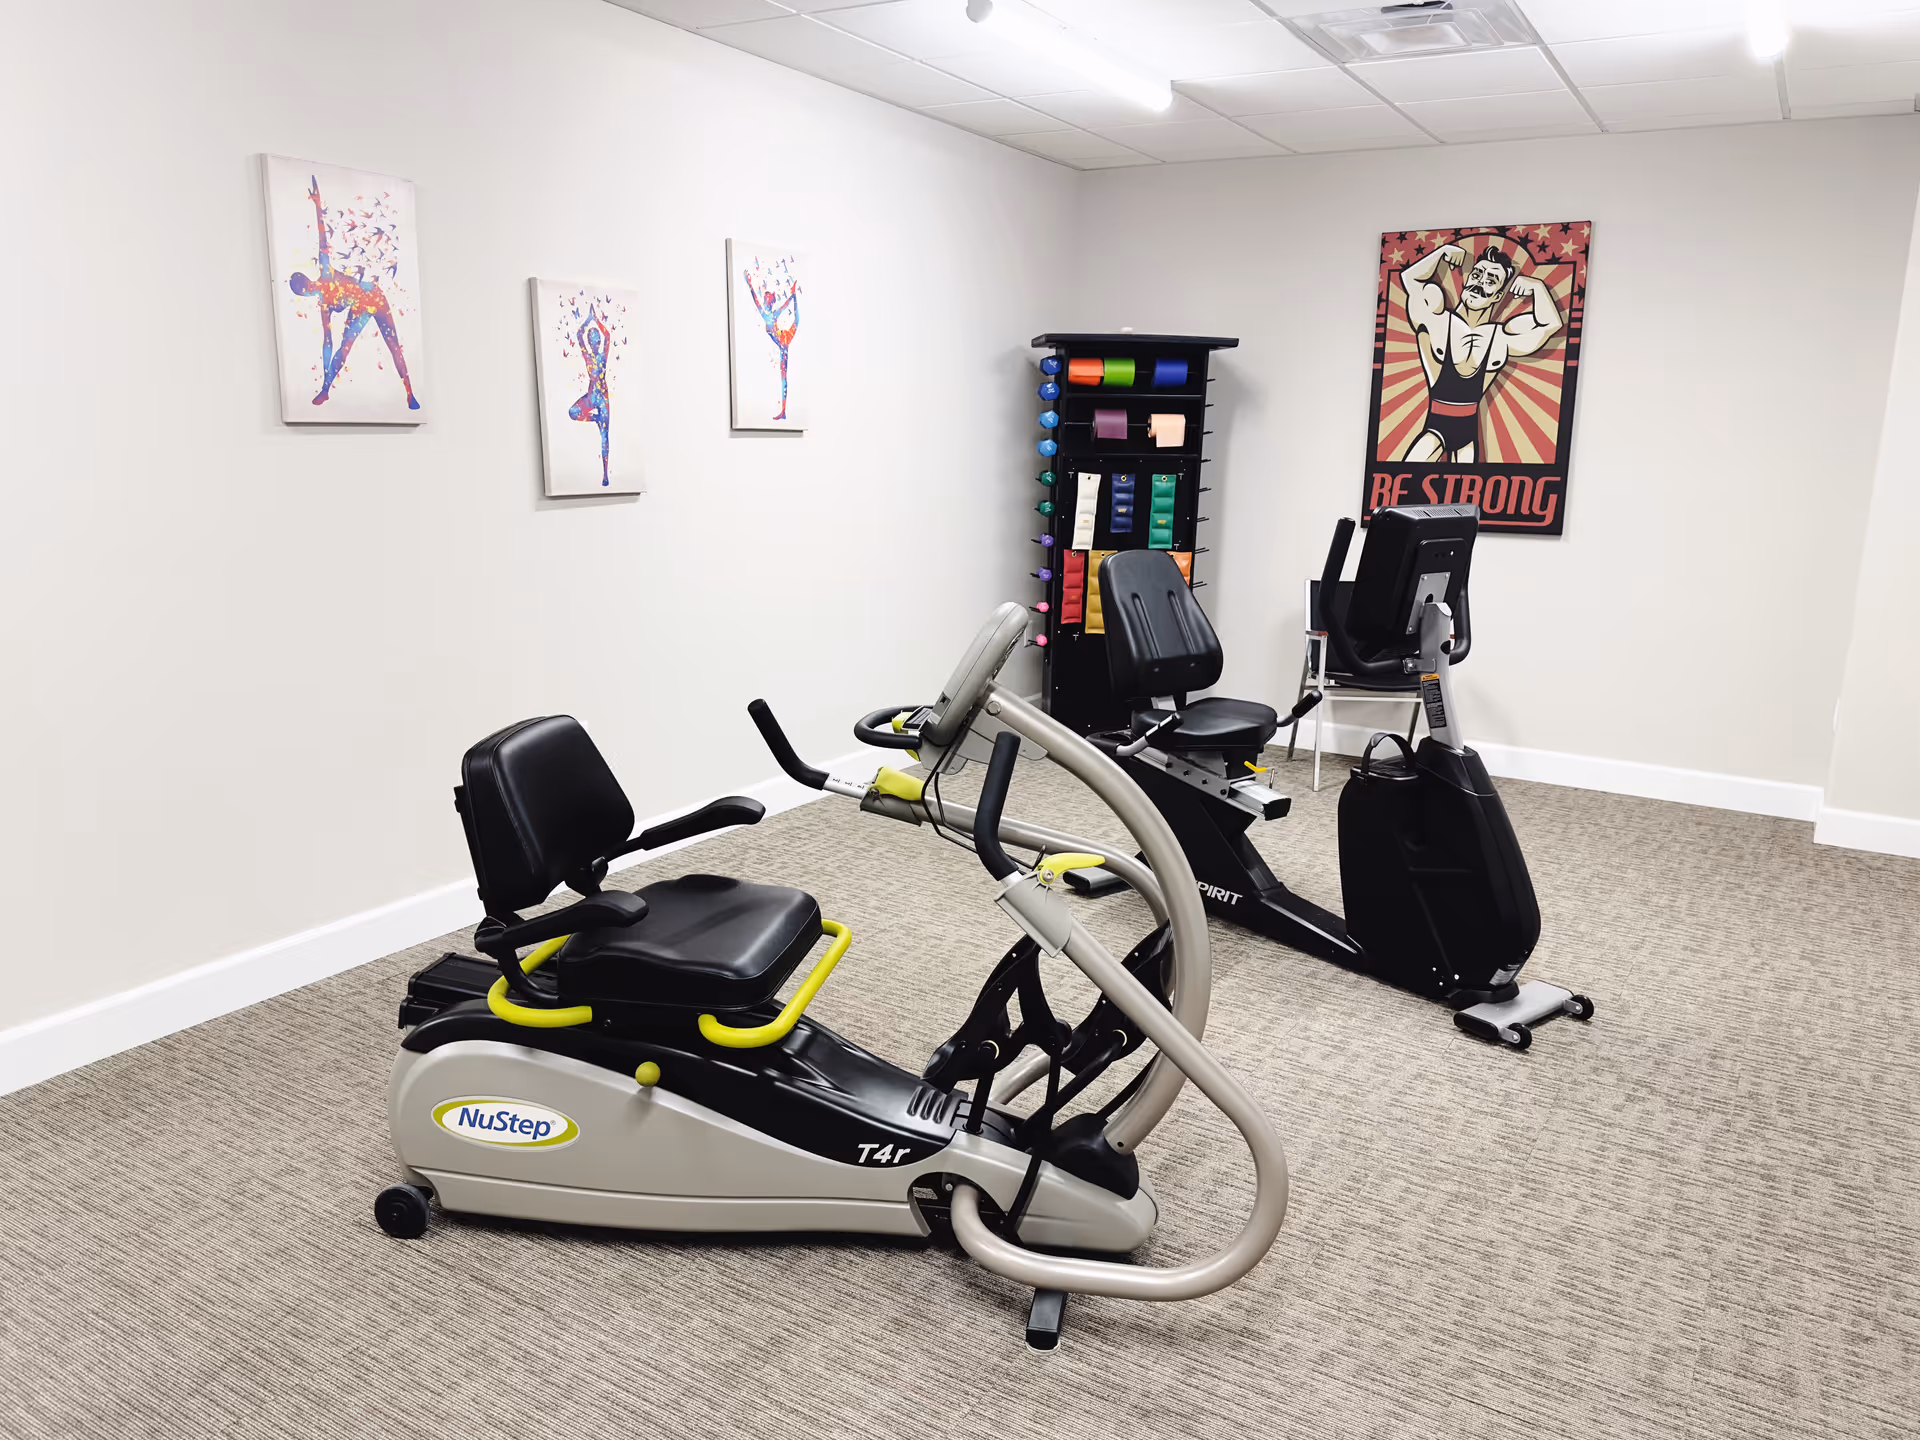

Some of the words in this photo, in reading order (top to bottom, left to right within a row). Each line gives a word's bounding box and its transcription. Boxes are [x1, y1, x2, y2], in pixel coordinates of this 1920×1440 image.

[1369, 473, 1413, 510] BE
[1421, 474, 1561, 526] STRONG
[1195, 880, 1244, 906] PIRIT
[458, 1107, 552, 1140] NuStep
[857, 1143, 911, 1164] T4r
